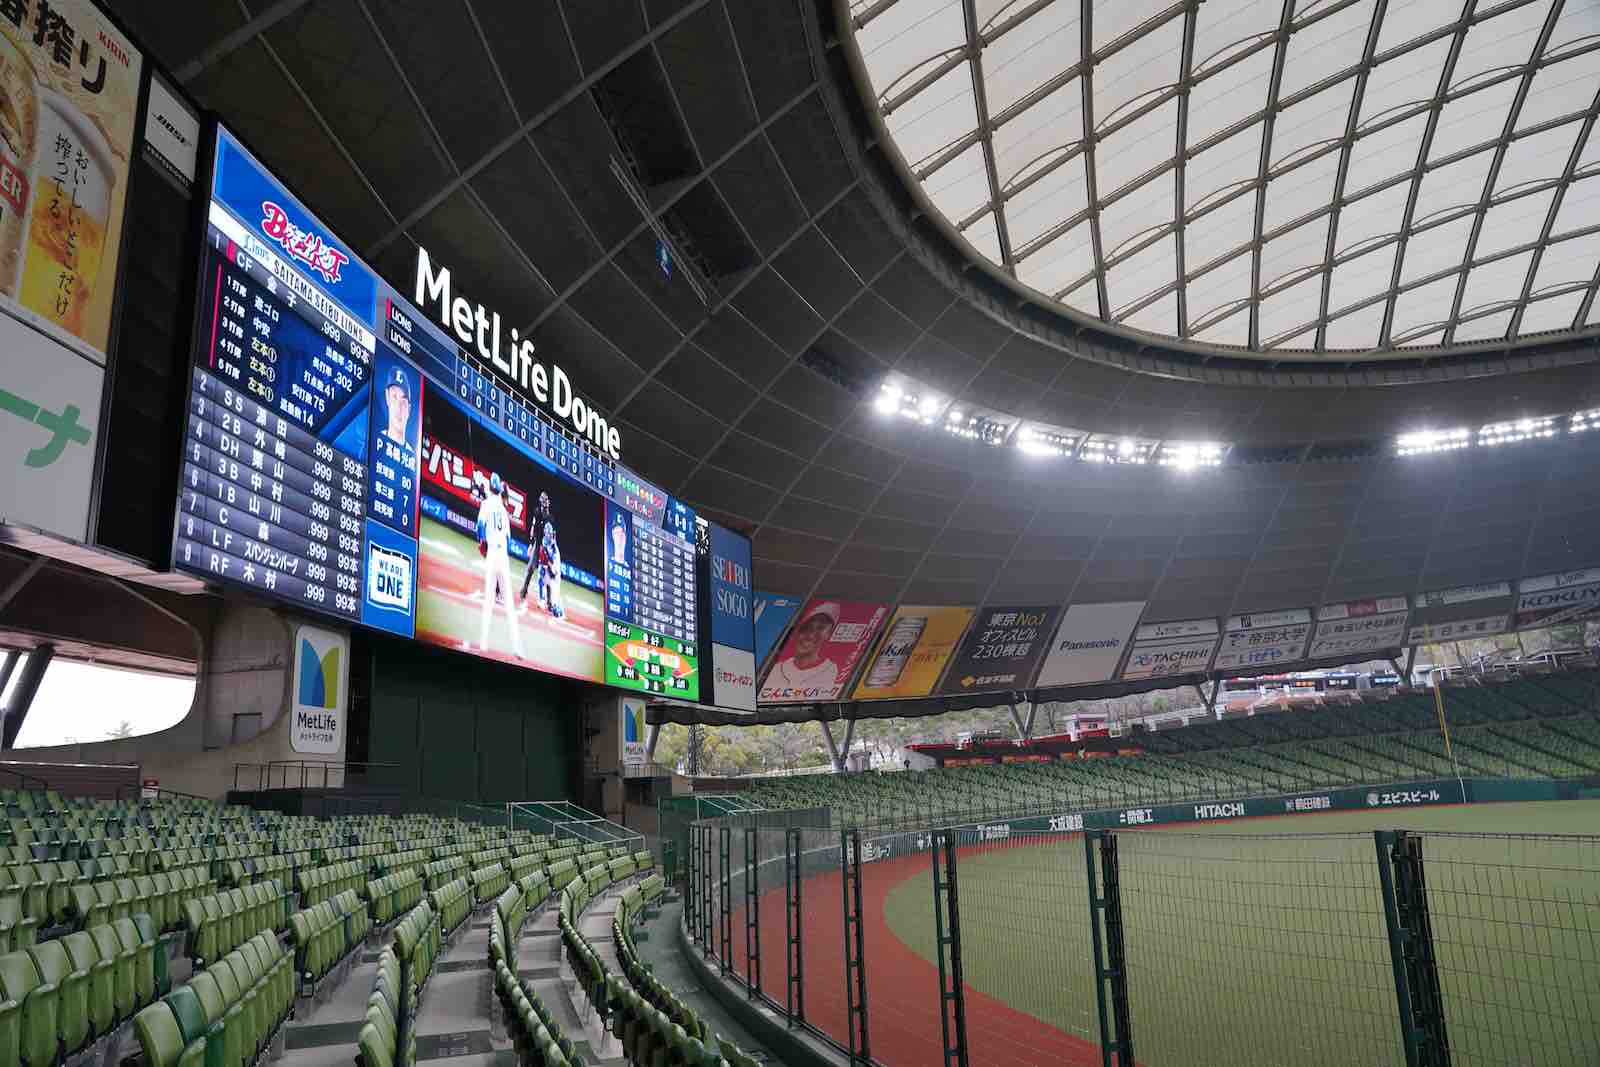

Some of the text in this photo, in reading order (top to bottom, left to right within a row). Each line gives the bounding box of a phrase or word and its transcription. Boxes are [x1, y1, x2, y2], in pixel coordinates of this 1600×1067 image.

[96, 31, 129, 67] KIRIN
[55, 149, 88, 316] おいしいとこだけ
[237, 252, 252, 272] CF
[273, 260, 312, 303] SAITAMA
[314, 294, 339, 322] SEIBU
[340, 314, 363, 343] LIONS
[391, 305, 412, 333] LIONS
[390, 328, 412, 354] LIONS
[416, 246, 548, 402] MetLife
[553, 365, 621, 460] Dome
[222, 414, 241, 435] 2B
[312, 461, 332, 481] .999
[342, 476, 362, 498] 99本
[224, 390, 243, 412] SS
[312, 442, 334, 462] .999
[344, 458, 363, 480] 99本
[218, 458, 238, 480] 3B
[251, 472, 283, 502] 中村
[309, 501, 330, 521] .999
[340, 515, 360, 536] 99本
[221, 433, 240, 457] DH
[310, 482, 331, 502] .999
[341, 495, 361, 517] 99本
[218, 483, 236, 503] 1B
[249, 495, 281, 524] 山川
[307, 522, 329, 541] .999
[339, 534, 359, 555] 99本
[219, 507, 228, 524] C
[306, 542, 328, 562] .999
[337, 553, 359, 574] 99本
[210, 553, 230, 576] RF
[243, 561, 277, 590] 木村
[303, 583, 325, 603] .999
[335, 594, 356, 614] 99本
[212, 529, 233, 549] LF
[305, 563, 326, 582] .999
[336, 574, 358, 594] 99本
[713, 556, 749, 592] SEIBU
[377, 573, 403, 599] ONE
[717, 588, 747, 619] SOGO
[1060, 638, 1120, 651] Panasonic
[1153, 648, 1208, 662] TACHIHI
[298, 712, 336, 730] MetLife
[1194, 802, 1245, 818] HITACHI
